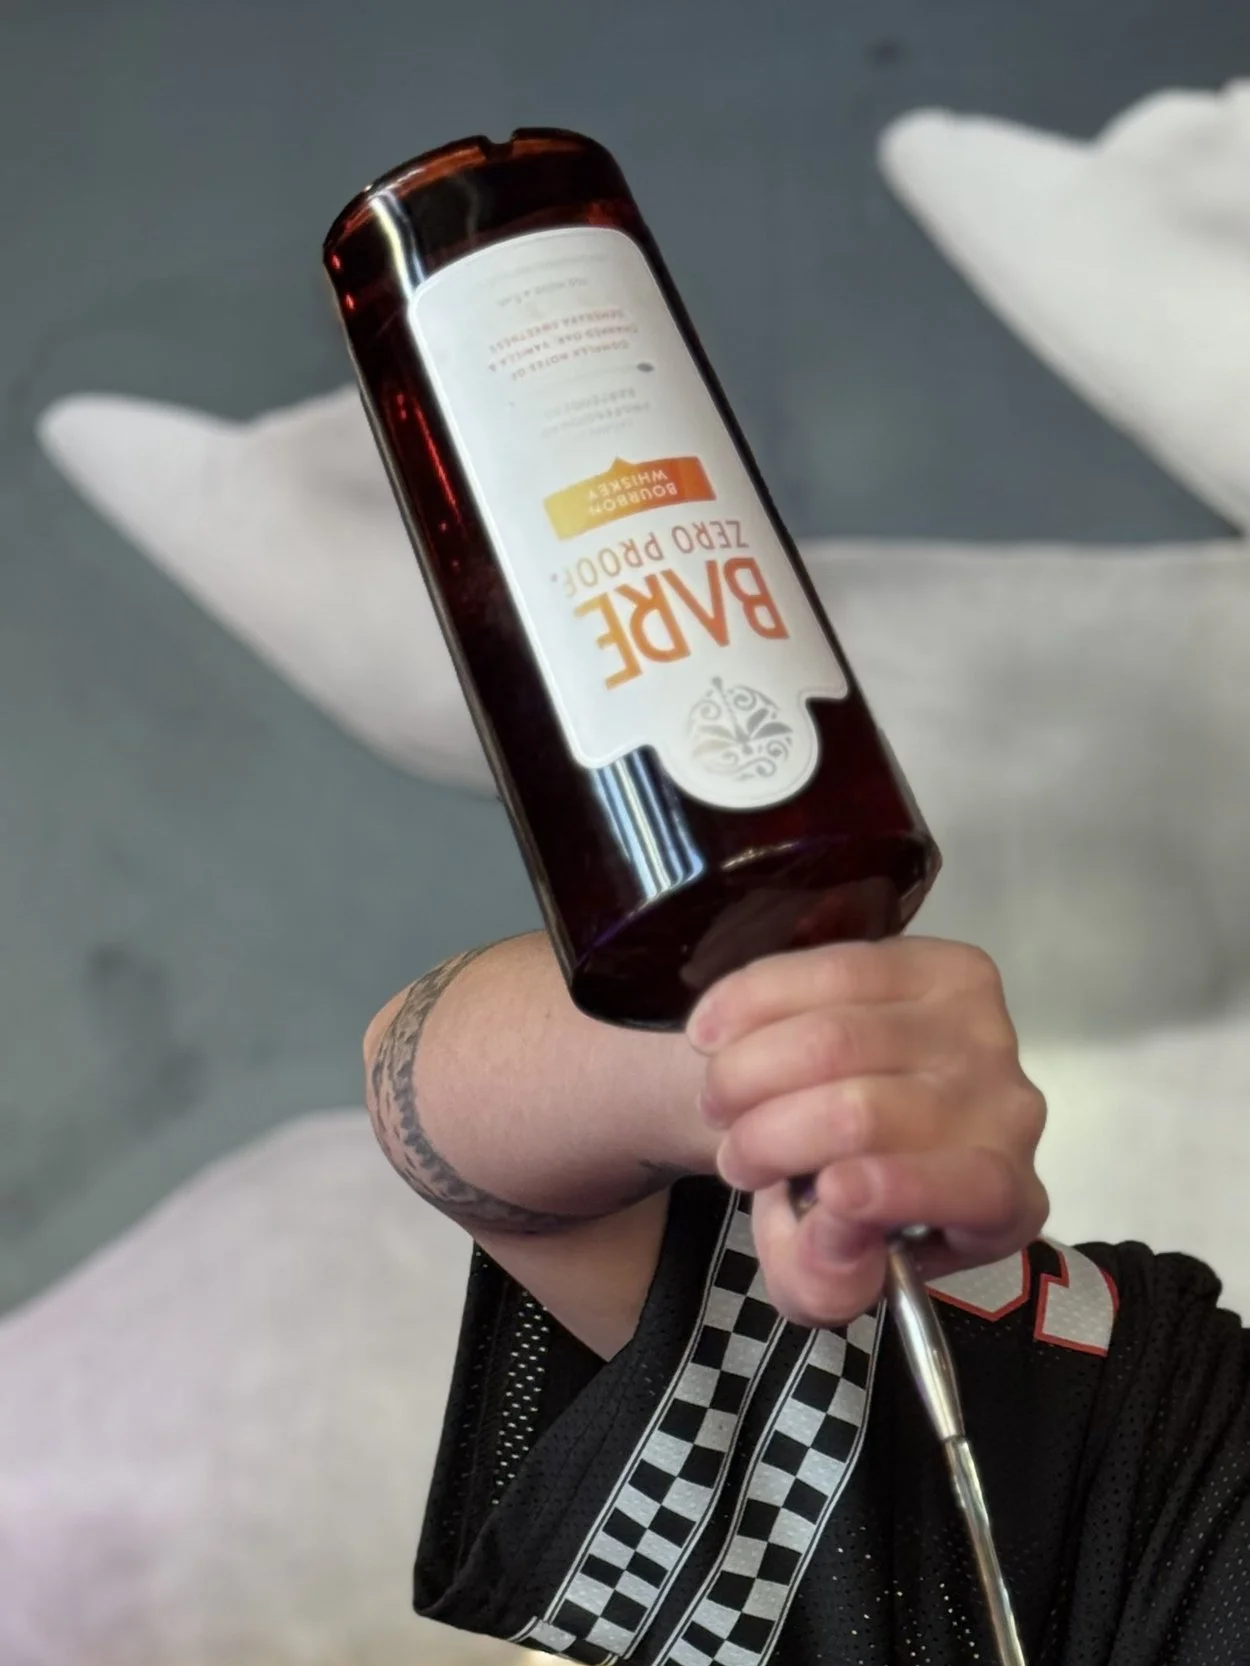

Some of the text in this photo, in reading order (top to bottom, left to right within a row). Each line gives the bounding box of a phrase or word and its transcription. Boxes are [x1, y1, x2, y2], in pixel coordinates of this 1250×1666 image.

[587, 468, 669, 500] WHISKEY
[588, 481, 678, 517] BOURBON
[561, 519, 750, 599] ZERO PROOF
[573, 556, 790, 690] BARE
